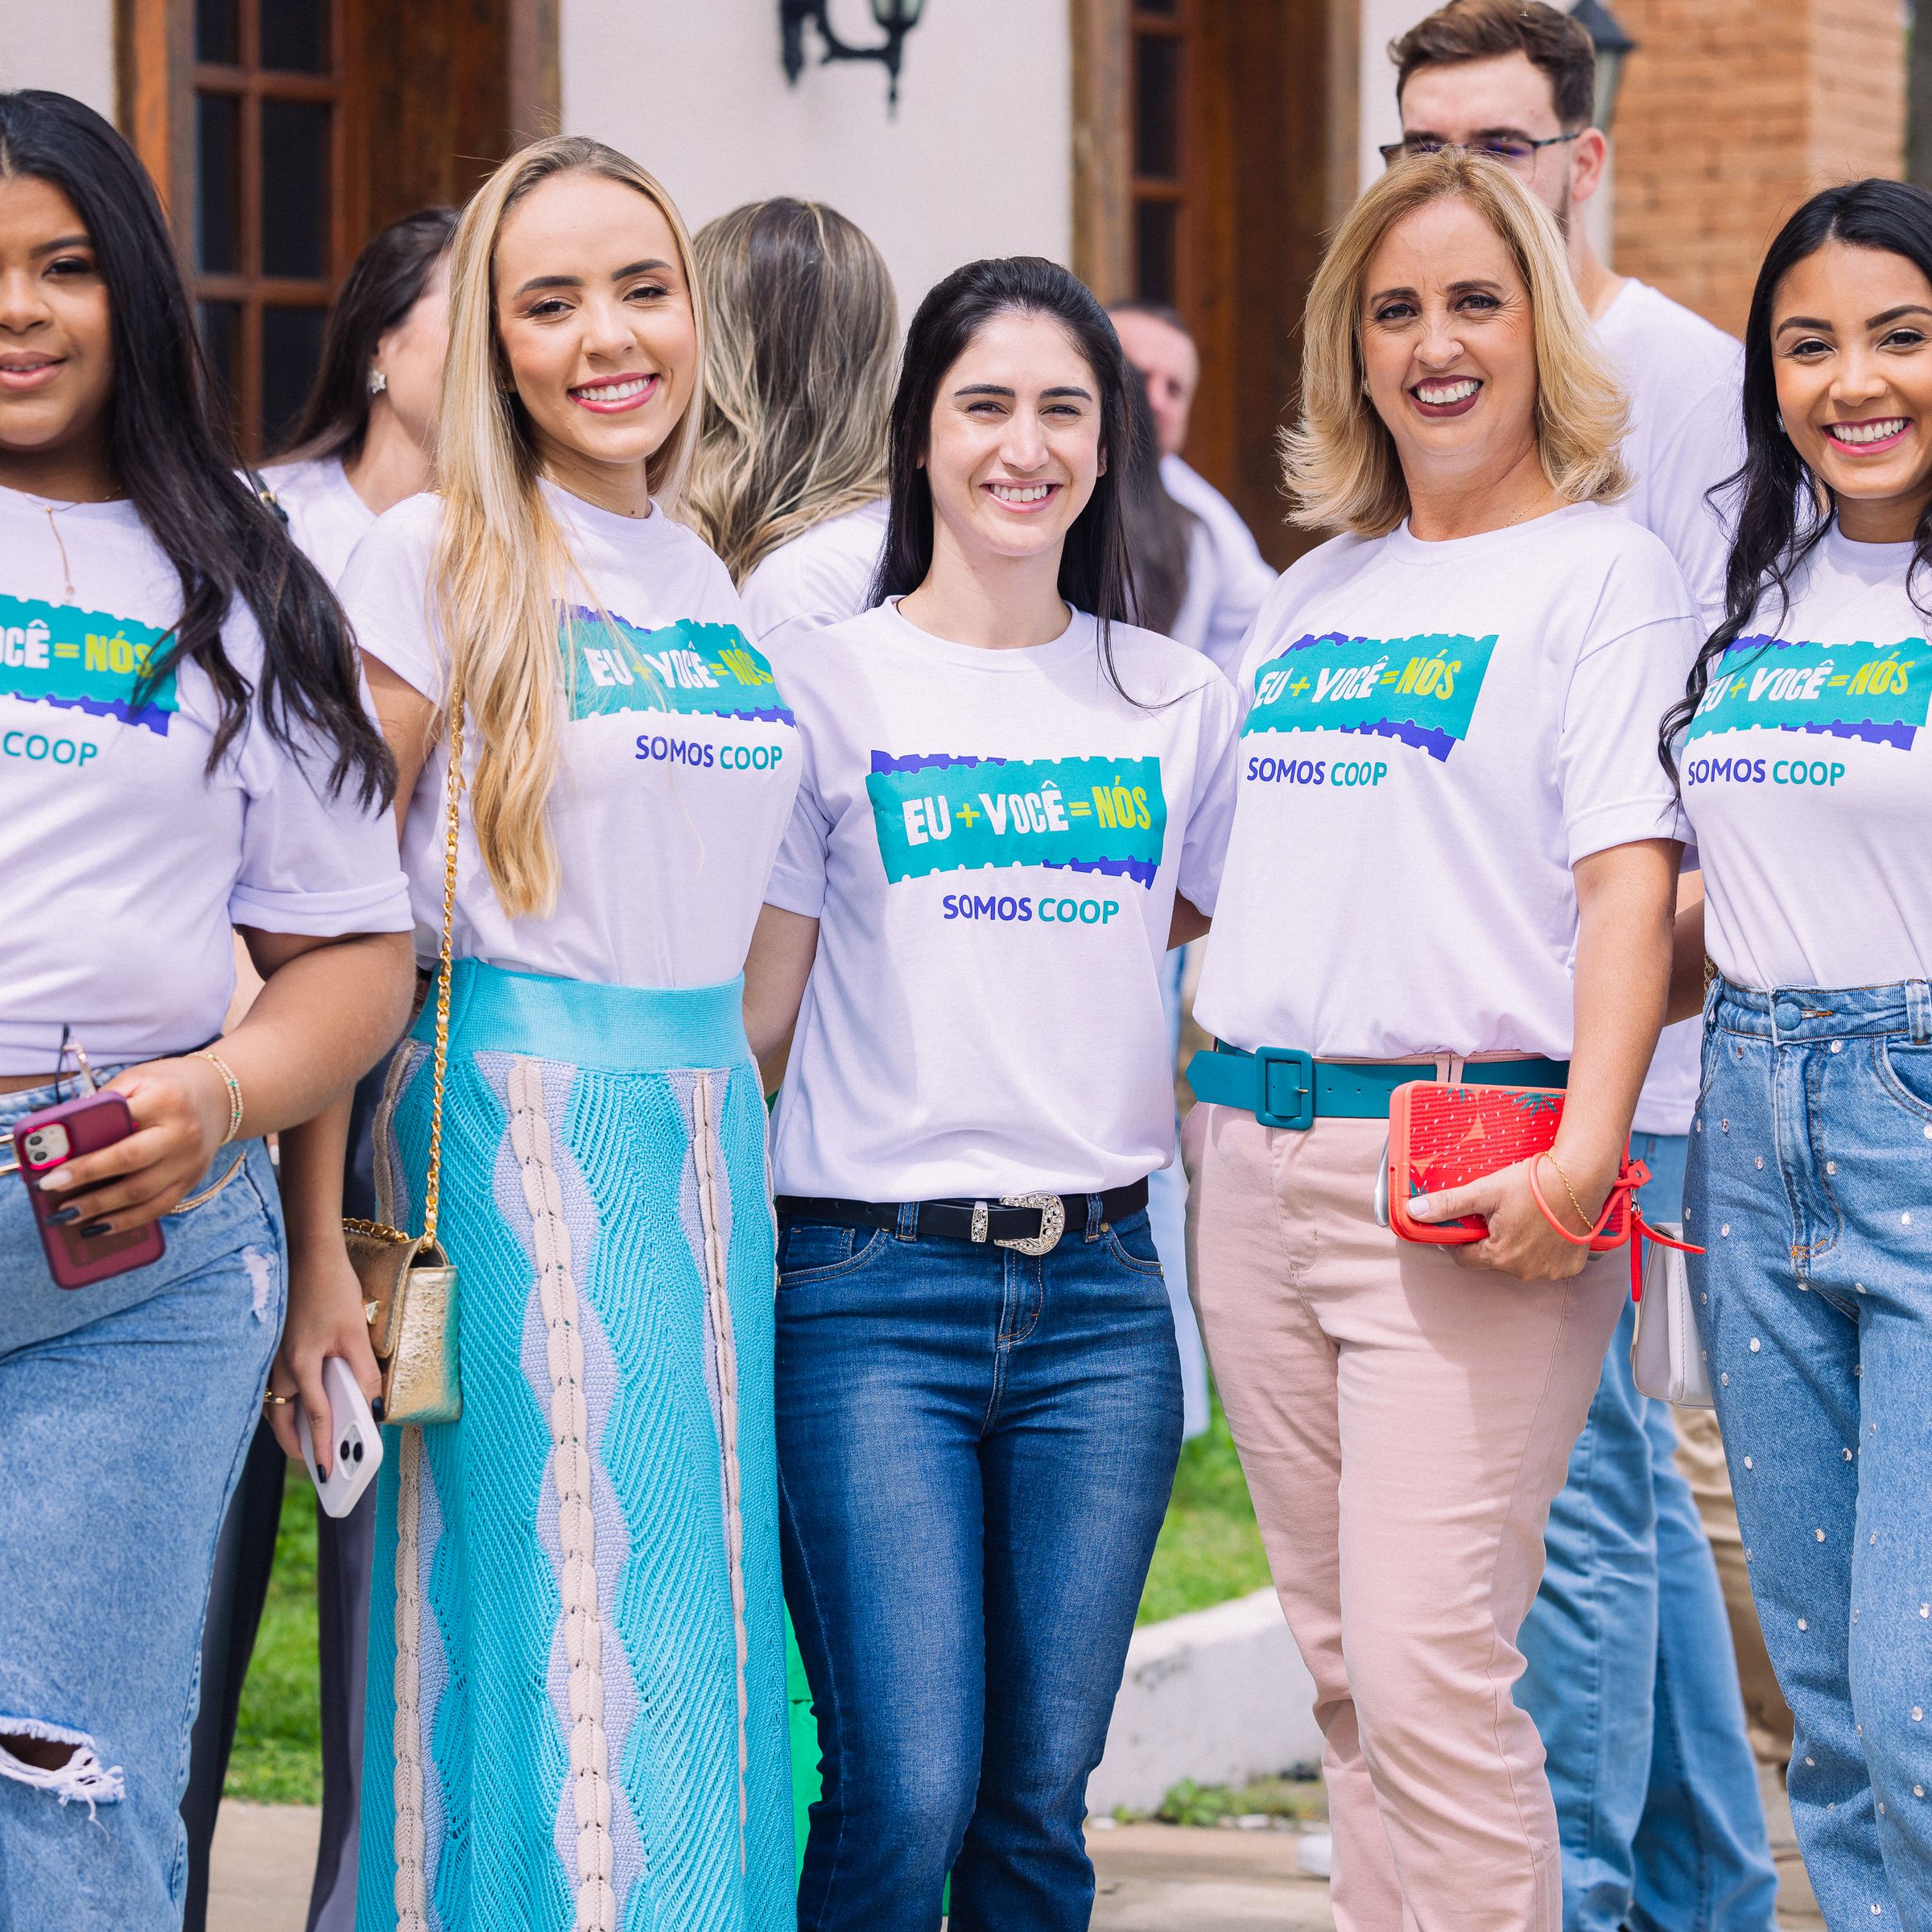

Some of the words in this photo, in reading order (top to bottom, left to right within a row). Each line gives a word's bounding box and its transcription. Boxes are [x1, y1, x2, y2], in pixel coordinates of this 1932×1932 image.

[0, 618, 51, 669] CÊ
[85, 630, 155, 679] NÓS
[584, 647, 634, 687] EU
[718, 638, 774, 686] NÓS
[1251, 667, 1294, 711] EU
[1311, 654, 1389, 703] VOCÊ
[1393, 649, 1462, 700] NÓS
[1747, 659, 1835, 702] VOCÊ
[1846, 650, 1915, 696] NÓS
[3, 731, 98, 766] COOP
[635, 735, 714, 768] SOMOS
[720, 746, 782, 770] COOP
[1247, 757, 1326, 786] SOMOS
[1331, 762, 1388, 786] COOP
[1688, 758, 1766, 786] SOMOS
[1773, 760, 1845, 786] COOP
[902, 795, 952, 847] EU
[978, 779, 1069, 835] VOCÊ
[1091, 774, 1152, 830] NÓS
[942, 894, 1033, 922] SOMOS
[1038, 898, 1120, 925] COOP
